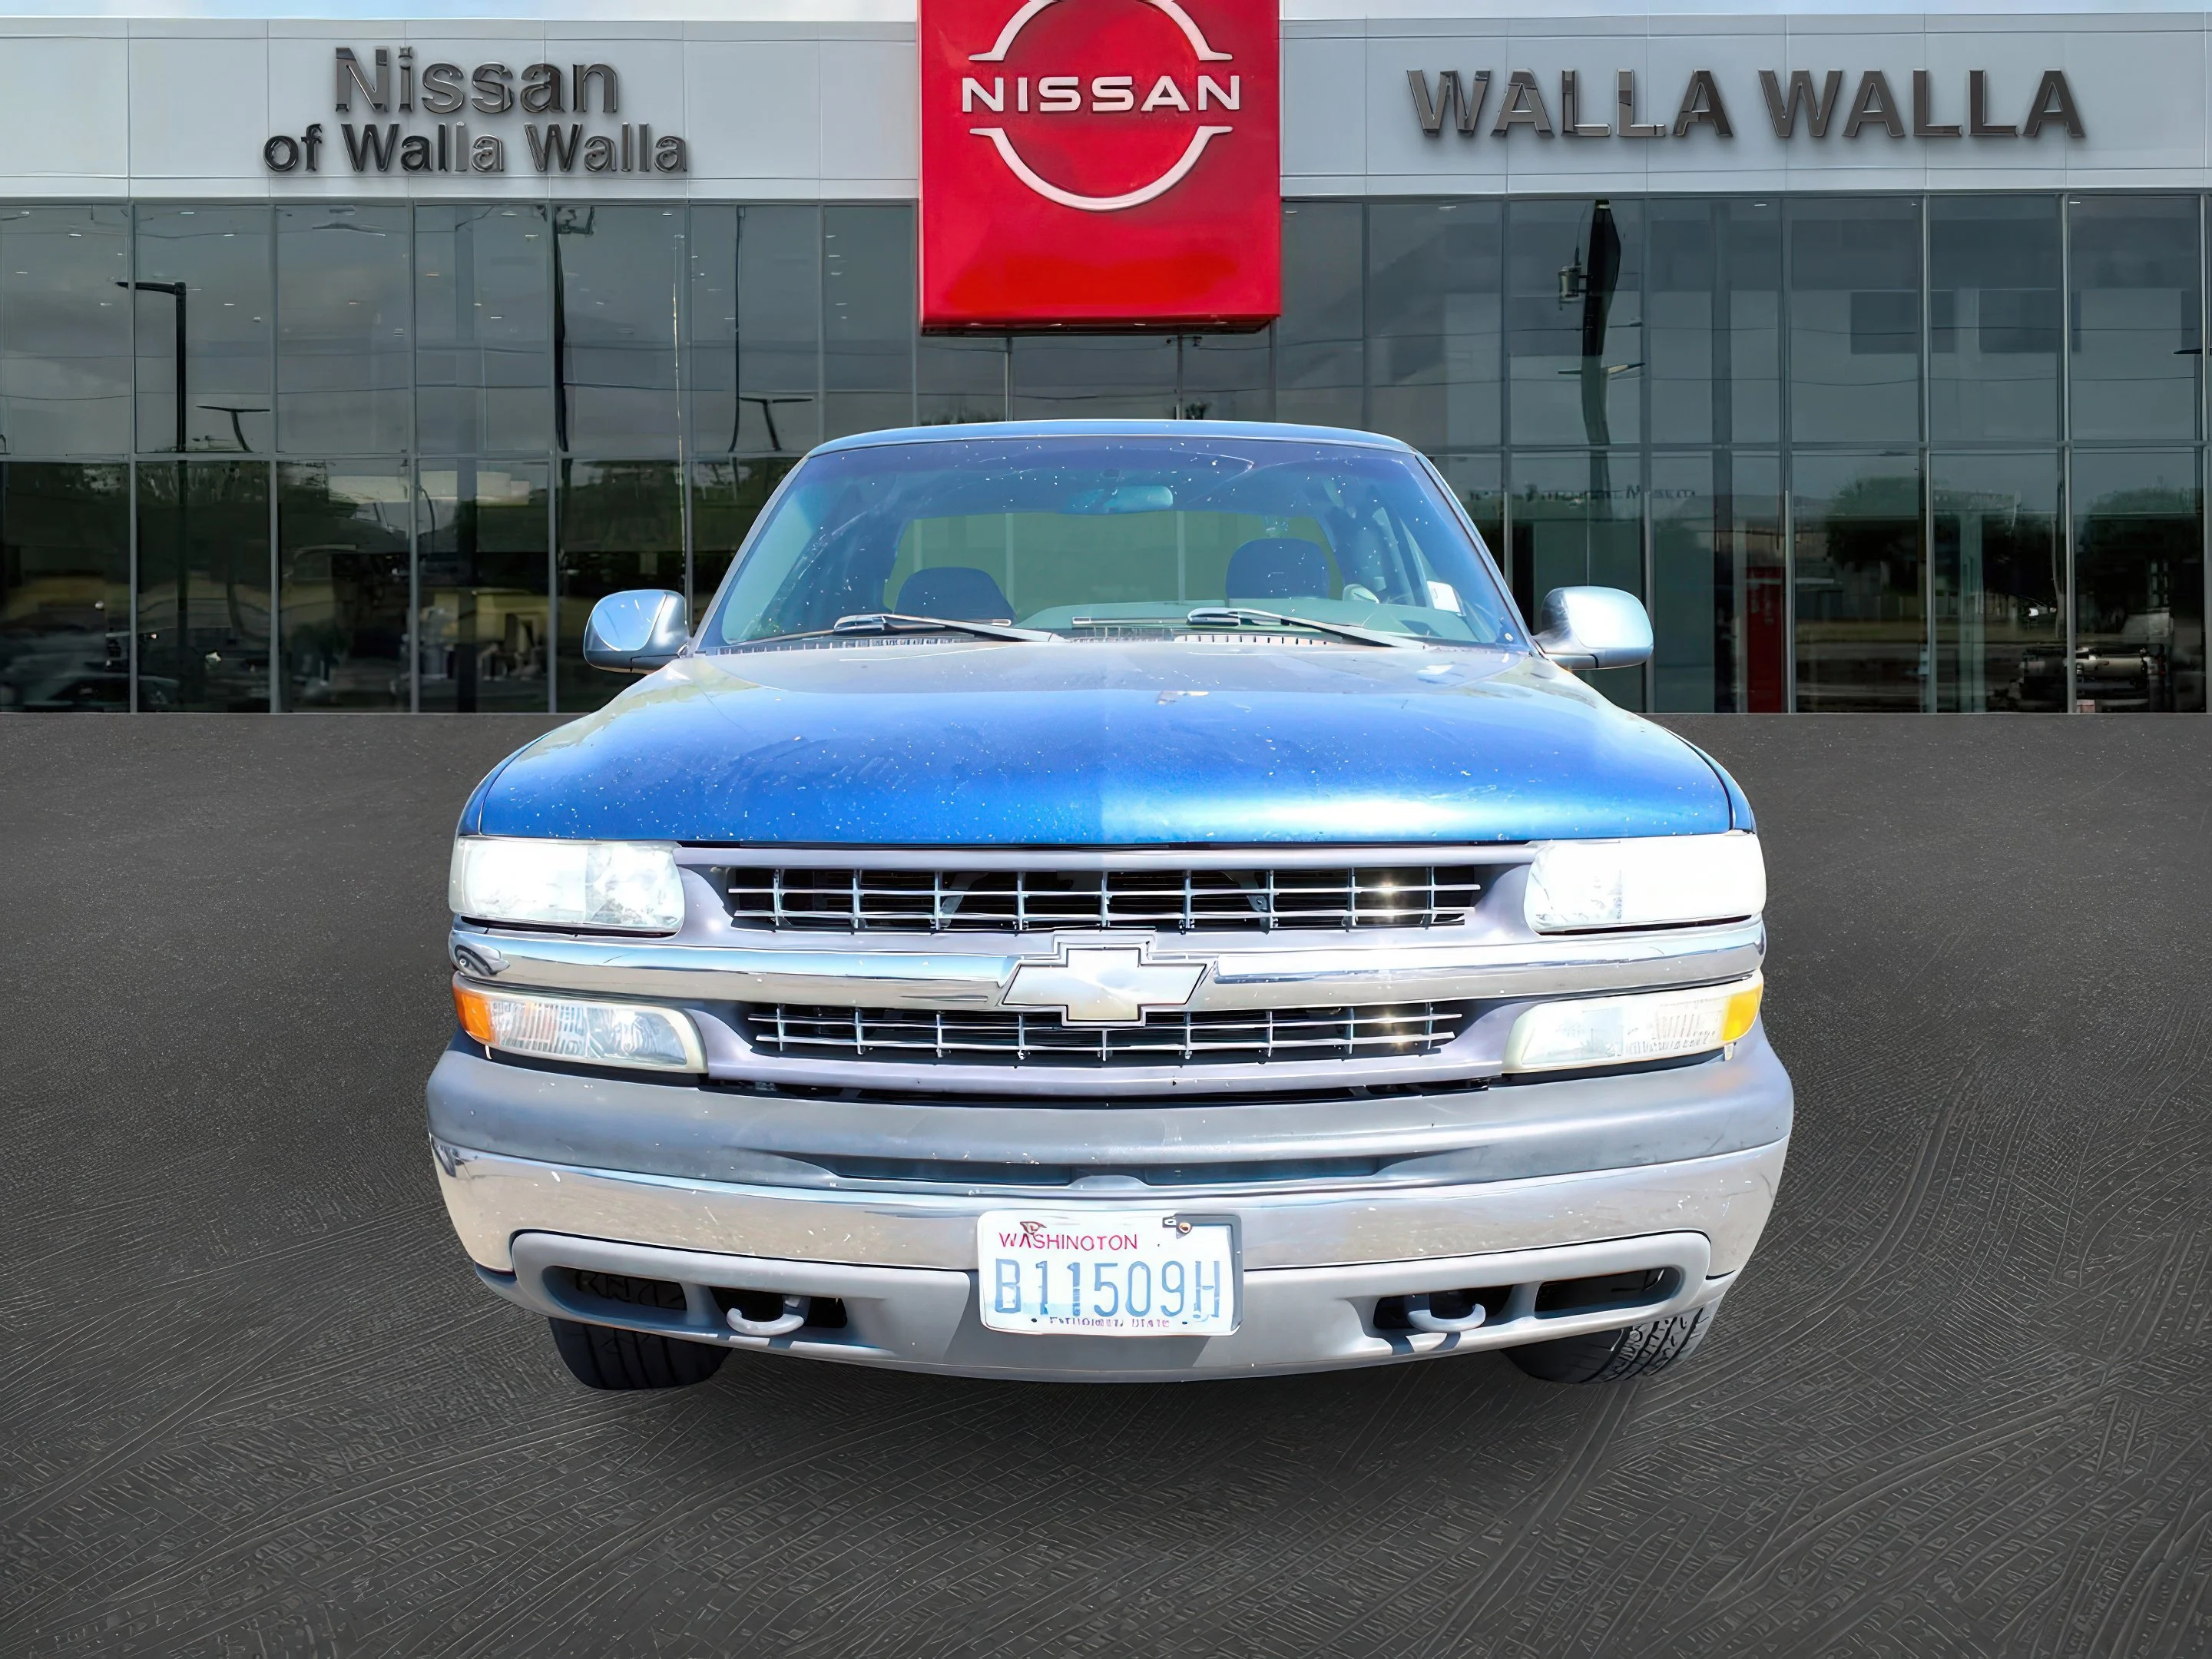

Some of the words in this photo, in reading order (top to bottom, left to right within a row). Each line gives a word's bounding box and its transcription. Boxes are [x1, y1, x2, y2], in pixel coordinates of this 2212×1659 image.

[335, 46, 619, 115] Nissan
[961, 75, 1240, 113] NISSAN
[1406, 68, 1734, 138] WALLA
[1757, 67, 2085, 138] WALLA
[263, 123, 323, 173] of
[340, 121, 504, 173] Walla
[524, 121, 687, 173] Walla
[995, 1257, 1220, 1318] B11509H
